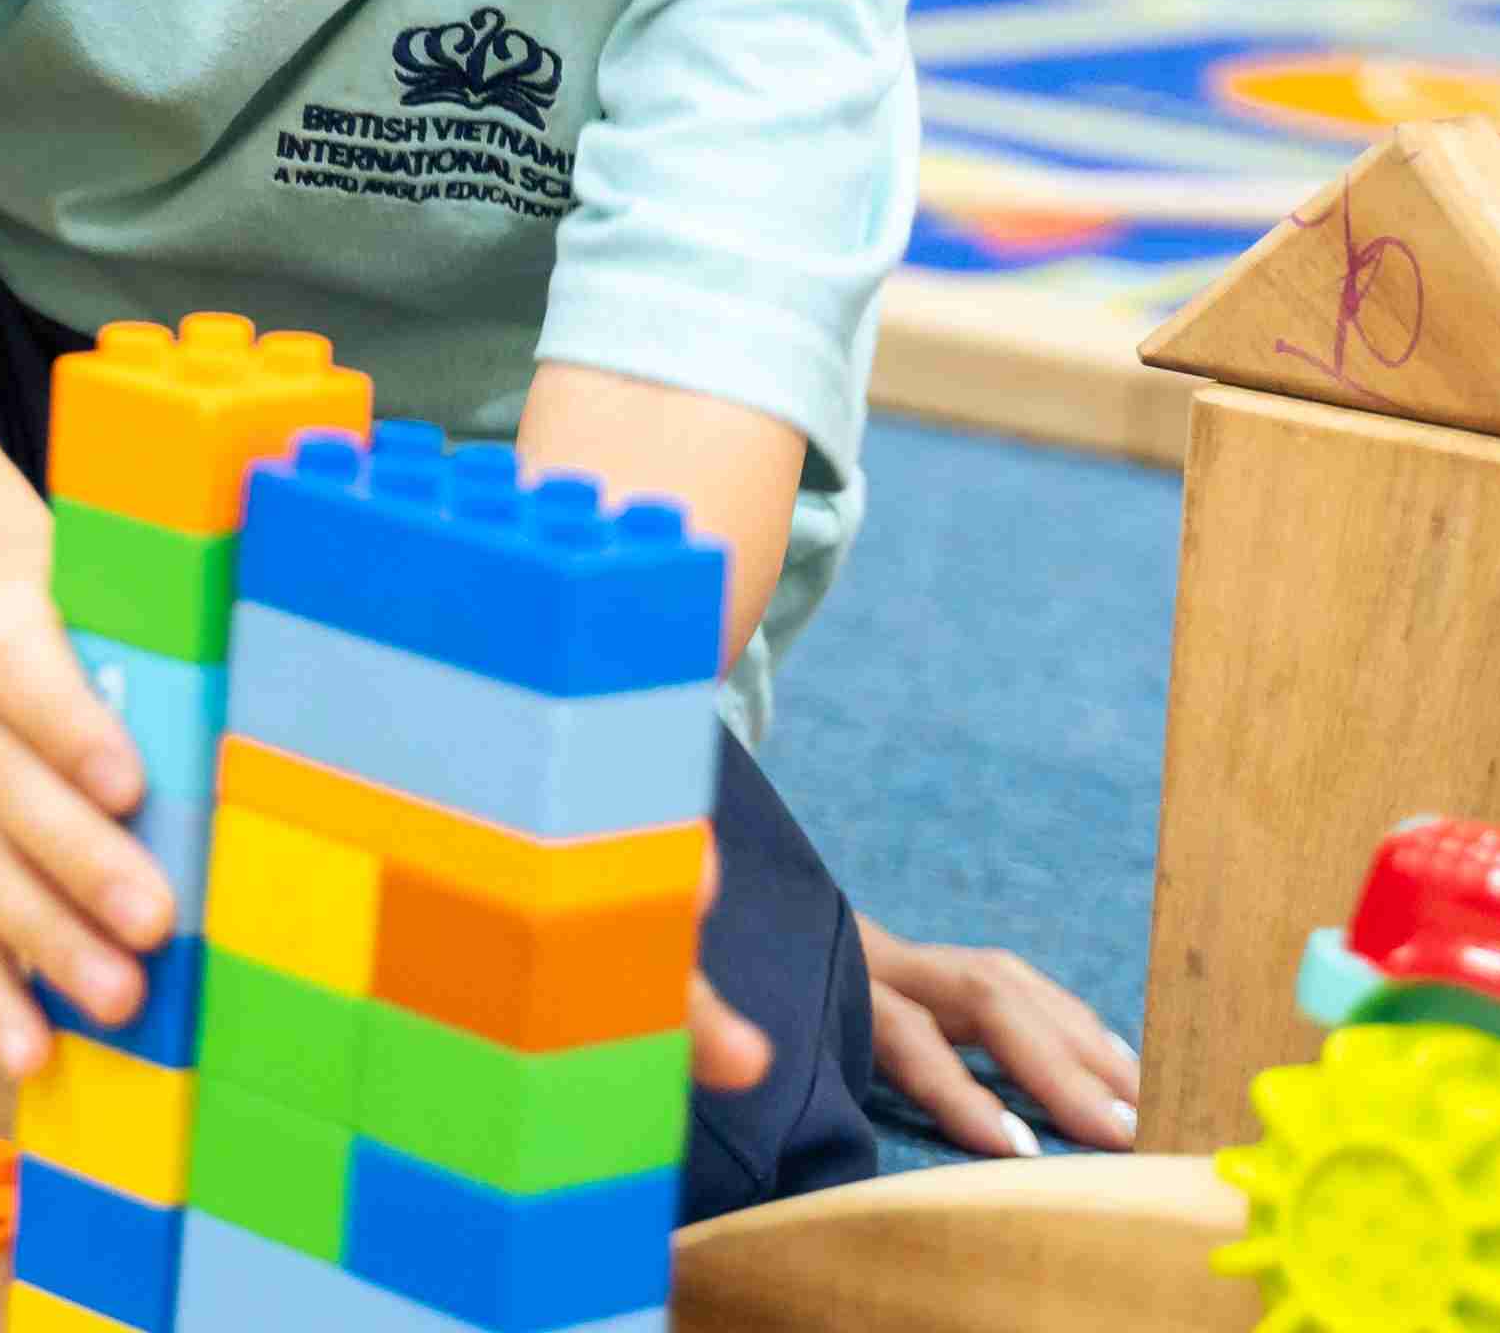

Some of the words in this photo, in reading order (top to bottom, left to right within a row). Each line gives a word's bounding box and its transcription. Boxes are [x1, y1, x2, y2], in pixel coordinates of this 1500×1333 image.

[303, 104, 427, 143] BRITISH
[276, 131, 514, 185] INTERNATIONAL
[274, 166, 291, 184] A
[296, 169, 358, 193] NORD
[360, 177, 440, 203] ANGLIA
[446, 182, 563, 218] EDUCATION
